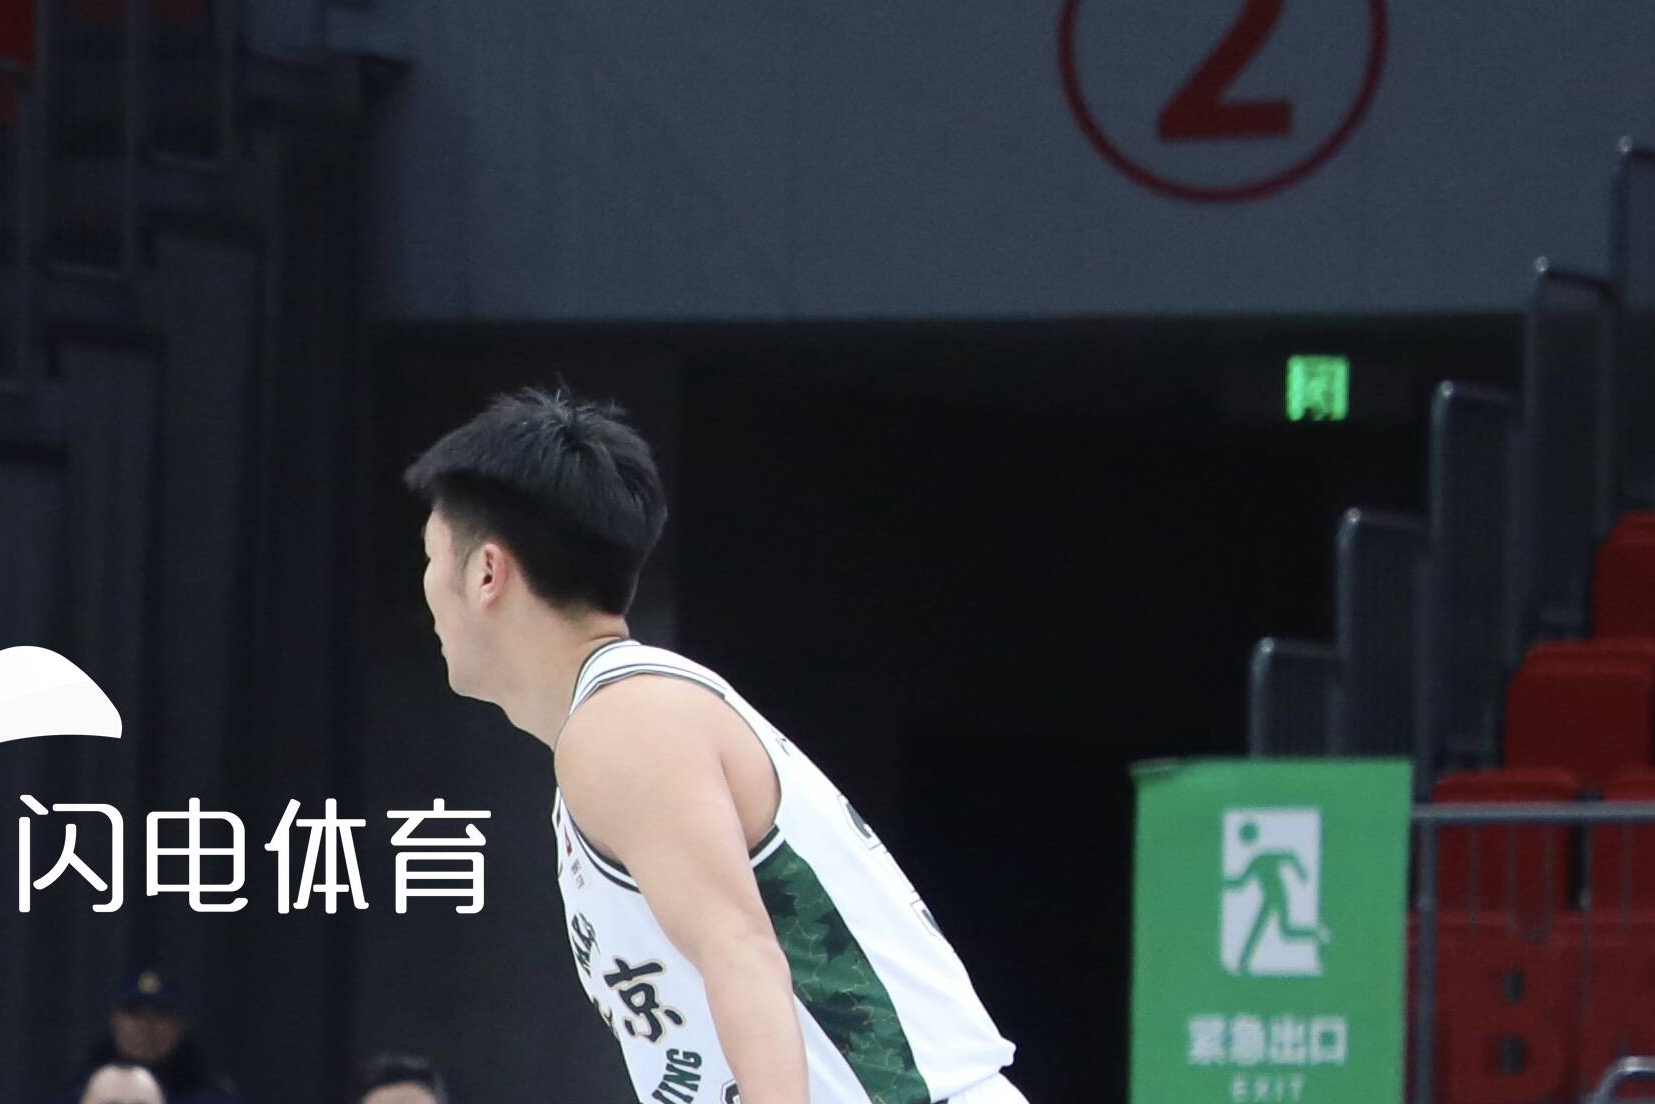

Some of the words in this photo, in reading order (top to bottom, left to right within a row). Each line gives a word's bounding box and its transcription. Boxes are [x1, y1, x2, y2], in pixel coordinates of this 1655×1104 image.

[1157, 0, 1293, 142] 2
[595, 957, 684, 1044] 京
[1189, 1013, 1348, 1066] 紧急出口
[1231, 1073, 1305, 1103] EXIT
